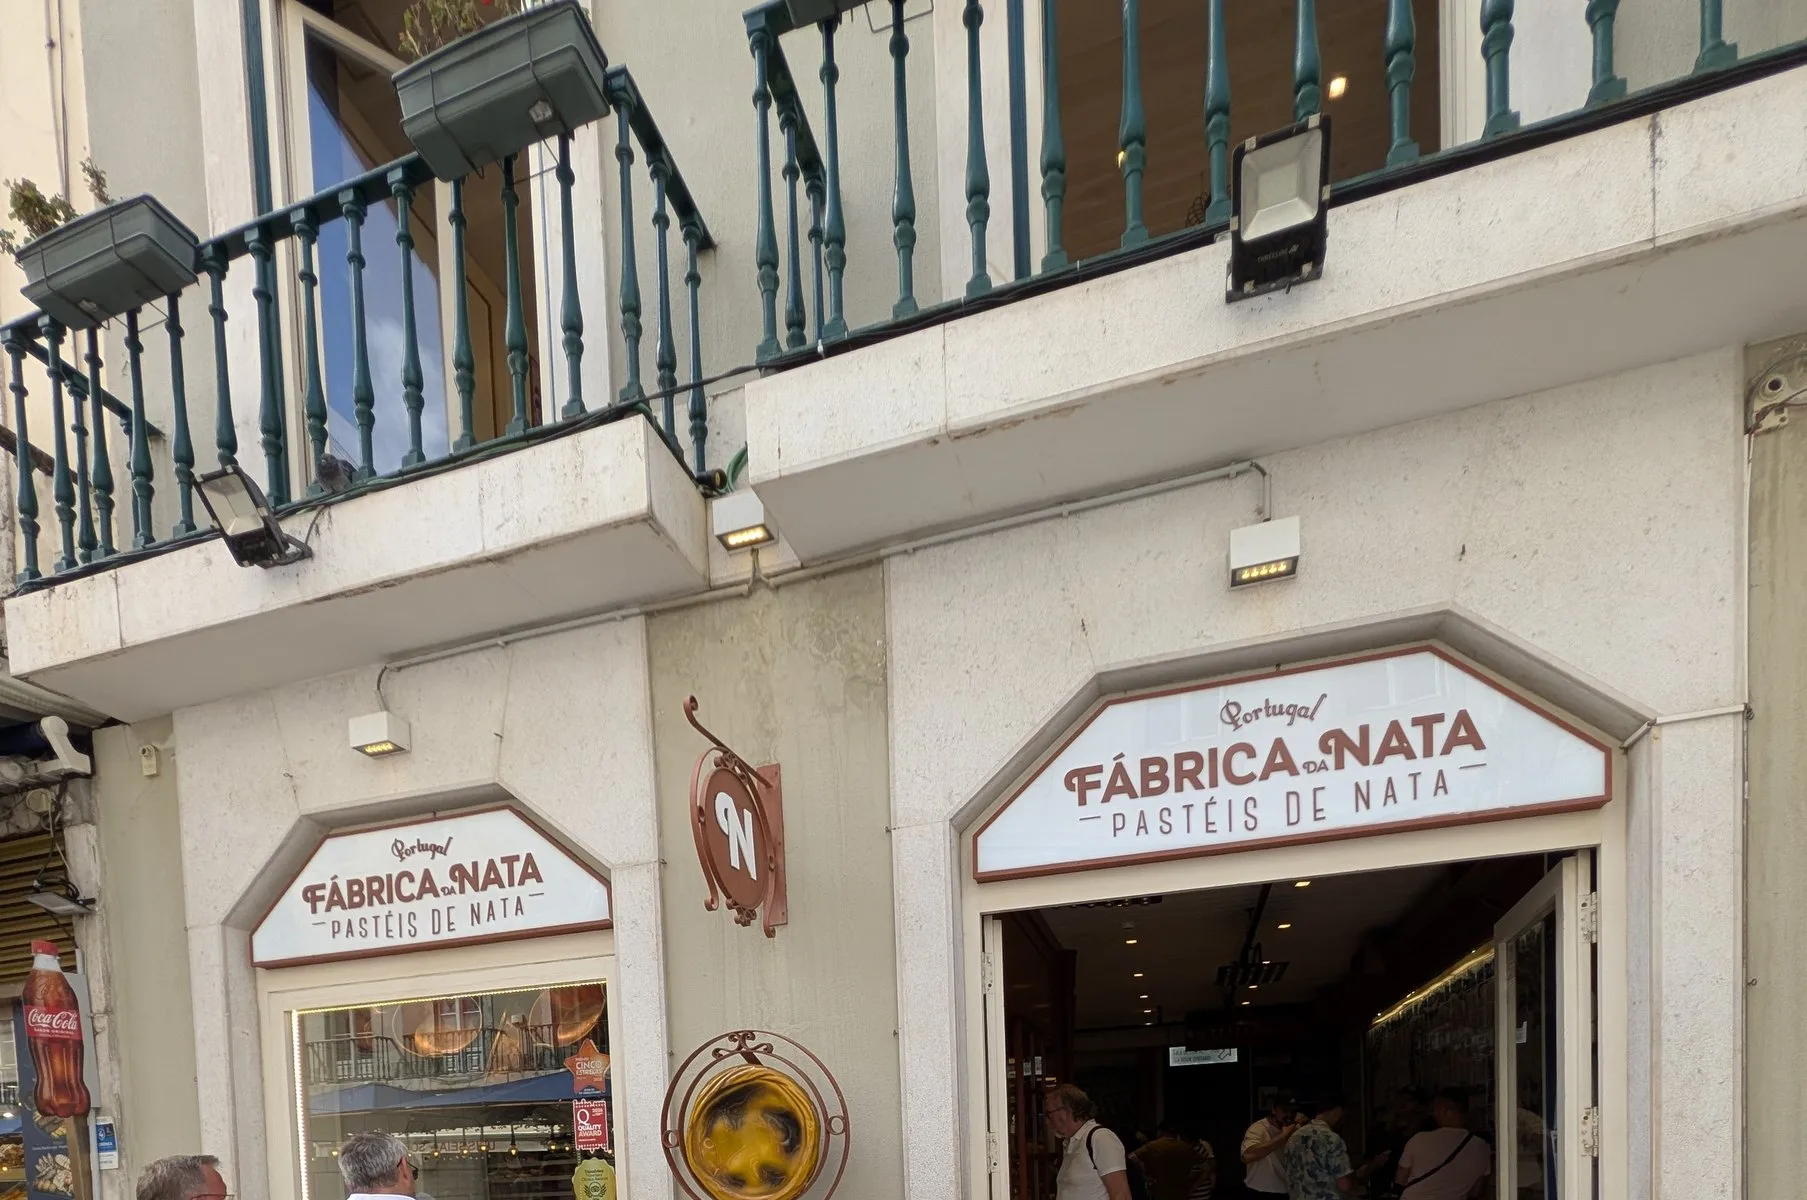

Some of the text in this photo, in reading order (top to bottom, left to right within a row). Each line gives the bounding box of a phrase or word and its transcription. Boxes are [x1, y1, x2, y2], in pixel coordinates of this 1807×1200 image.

[1219, 692, 1328, 731] Portugal
[1063, 708, 1487, 807] FÁBRICA DA NATA
[1111, 768, 1449, 838] PASTÉIS DE NATA
[390, 836, 454, 862] Portugal
[714, 791, 757, 881] N
[301, 852, 543, 915] FÁBRICA DA NATA
[331, 895, 525, 939] PASTÉIS DE NATA
[28, 1007, 78, 1030] Coca-Cola
[575, 1060, 603, 1070] CINCO
[577, 1108, 590, 1126] Q
[577, 1123, 602, 1131] QUALITY
